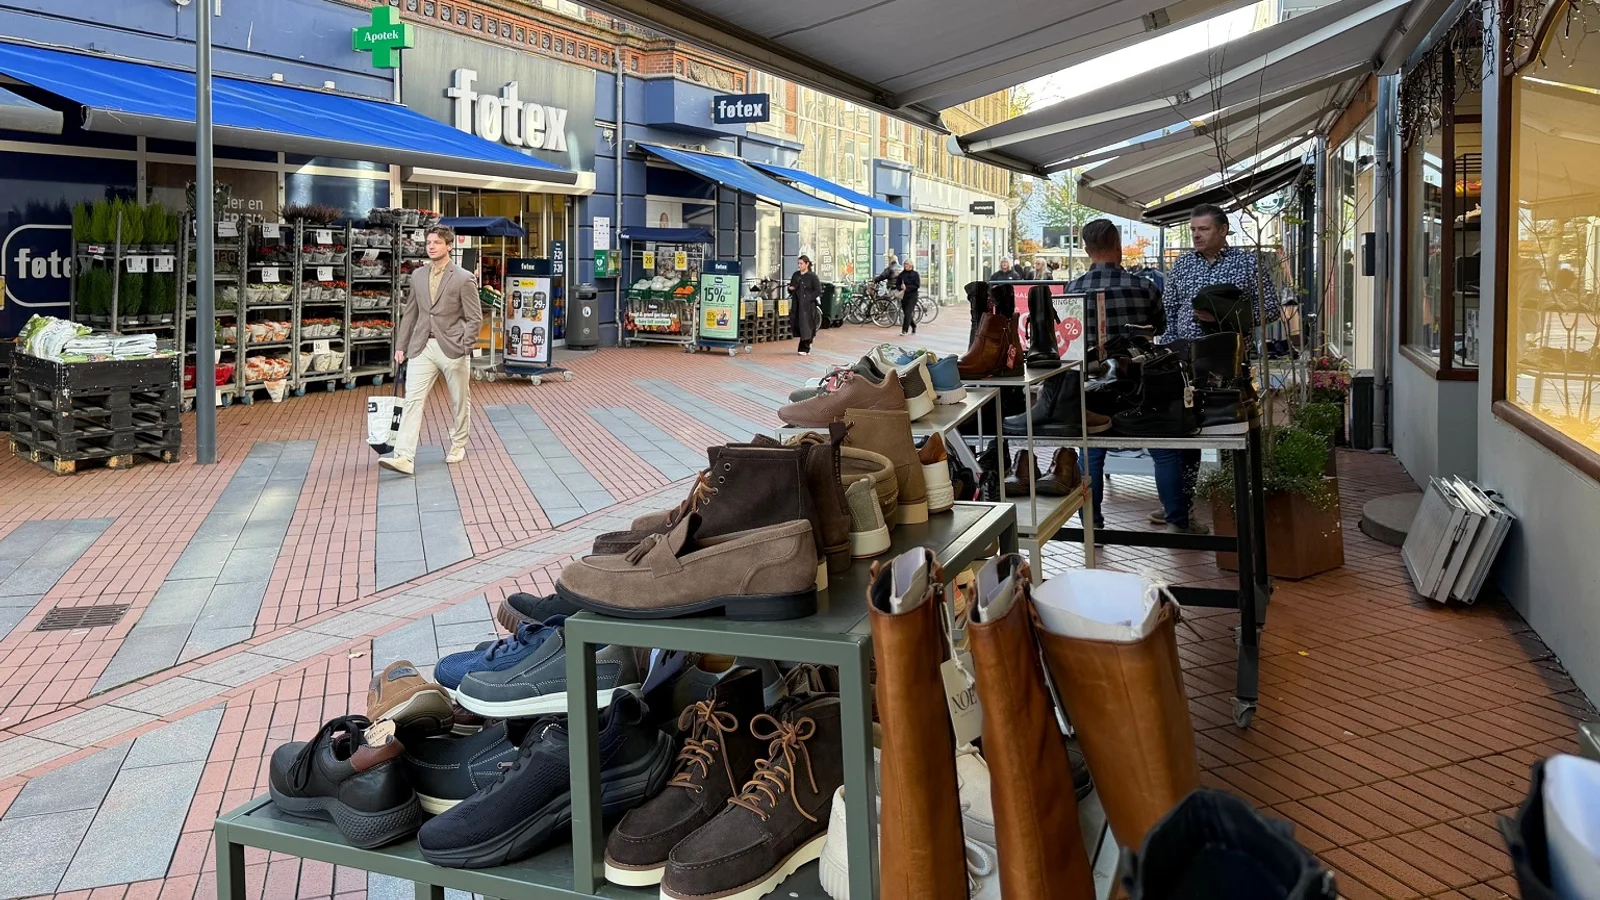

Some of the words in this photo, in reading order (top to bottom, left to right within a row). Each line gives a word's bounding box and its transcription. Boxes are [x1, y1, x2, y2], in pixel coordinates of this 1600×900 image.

[363, 29, 399, 43] Apotek
[447, 68, 568, 152] føtex
[718, 99, 763, 119] føtex
[248, 199, 263, 210] en
[704, 287, 726, 303] 15%
[1064, 322, 1079, 336] %
